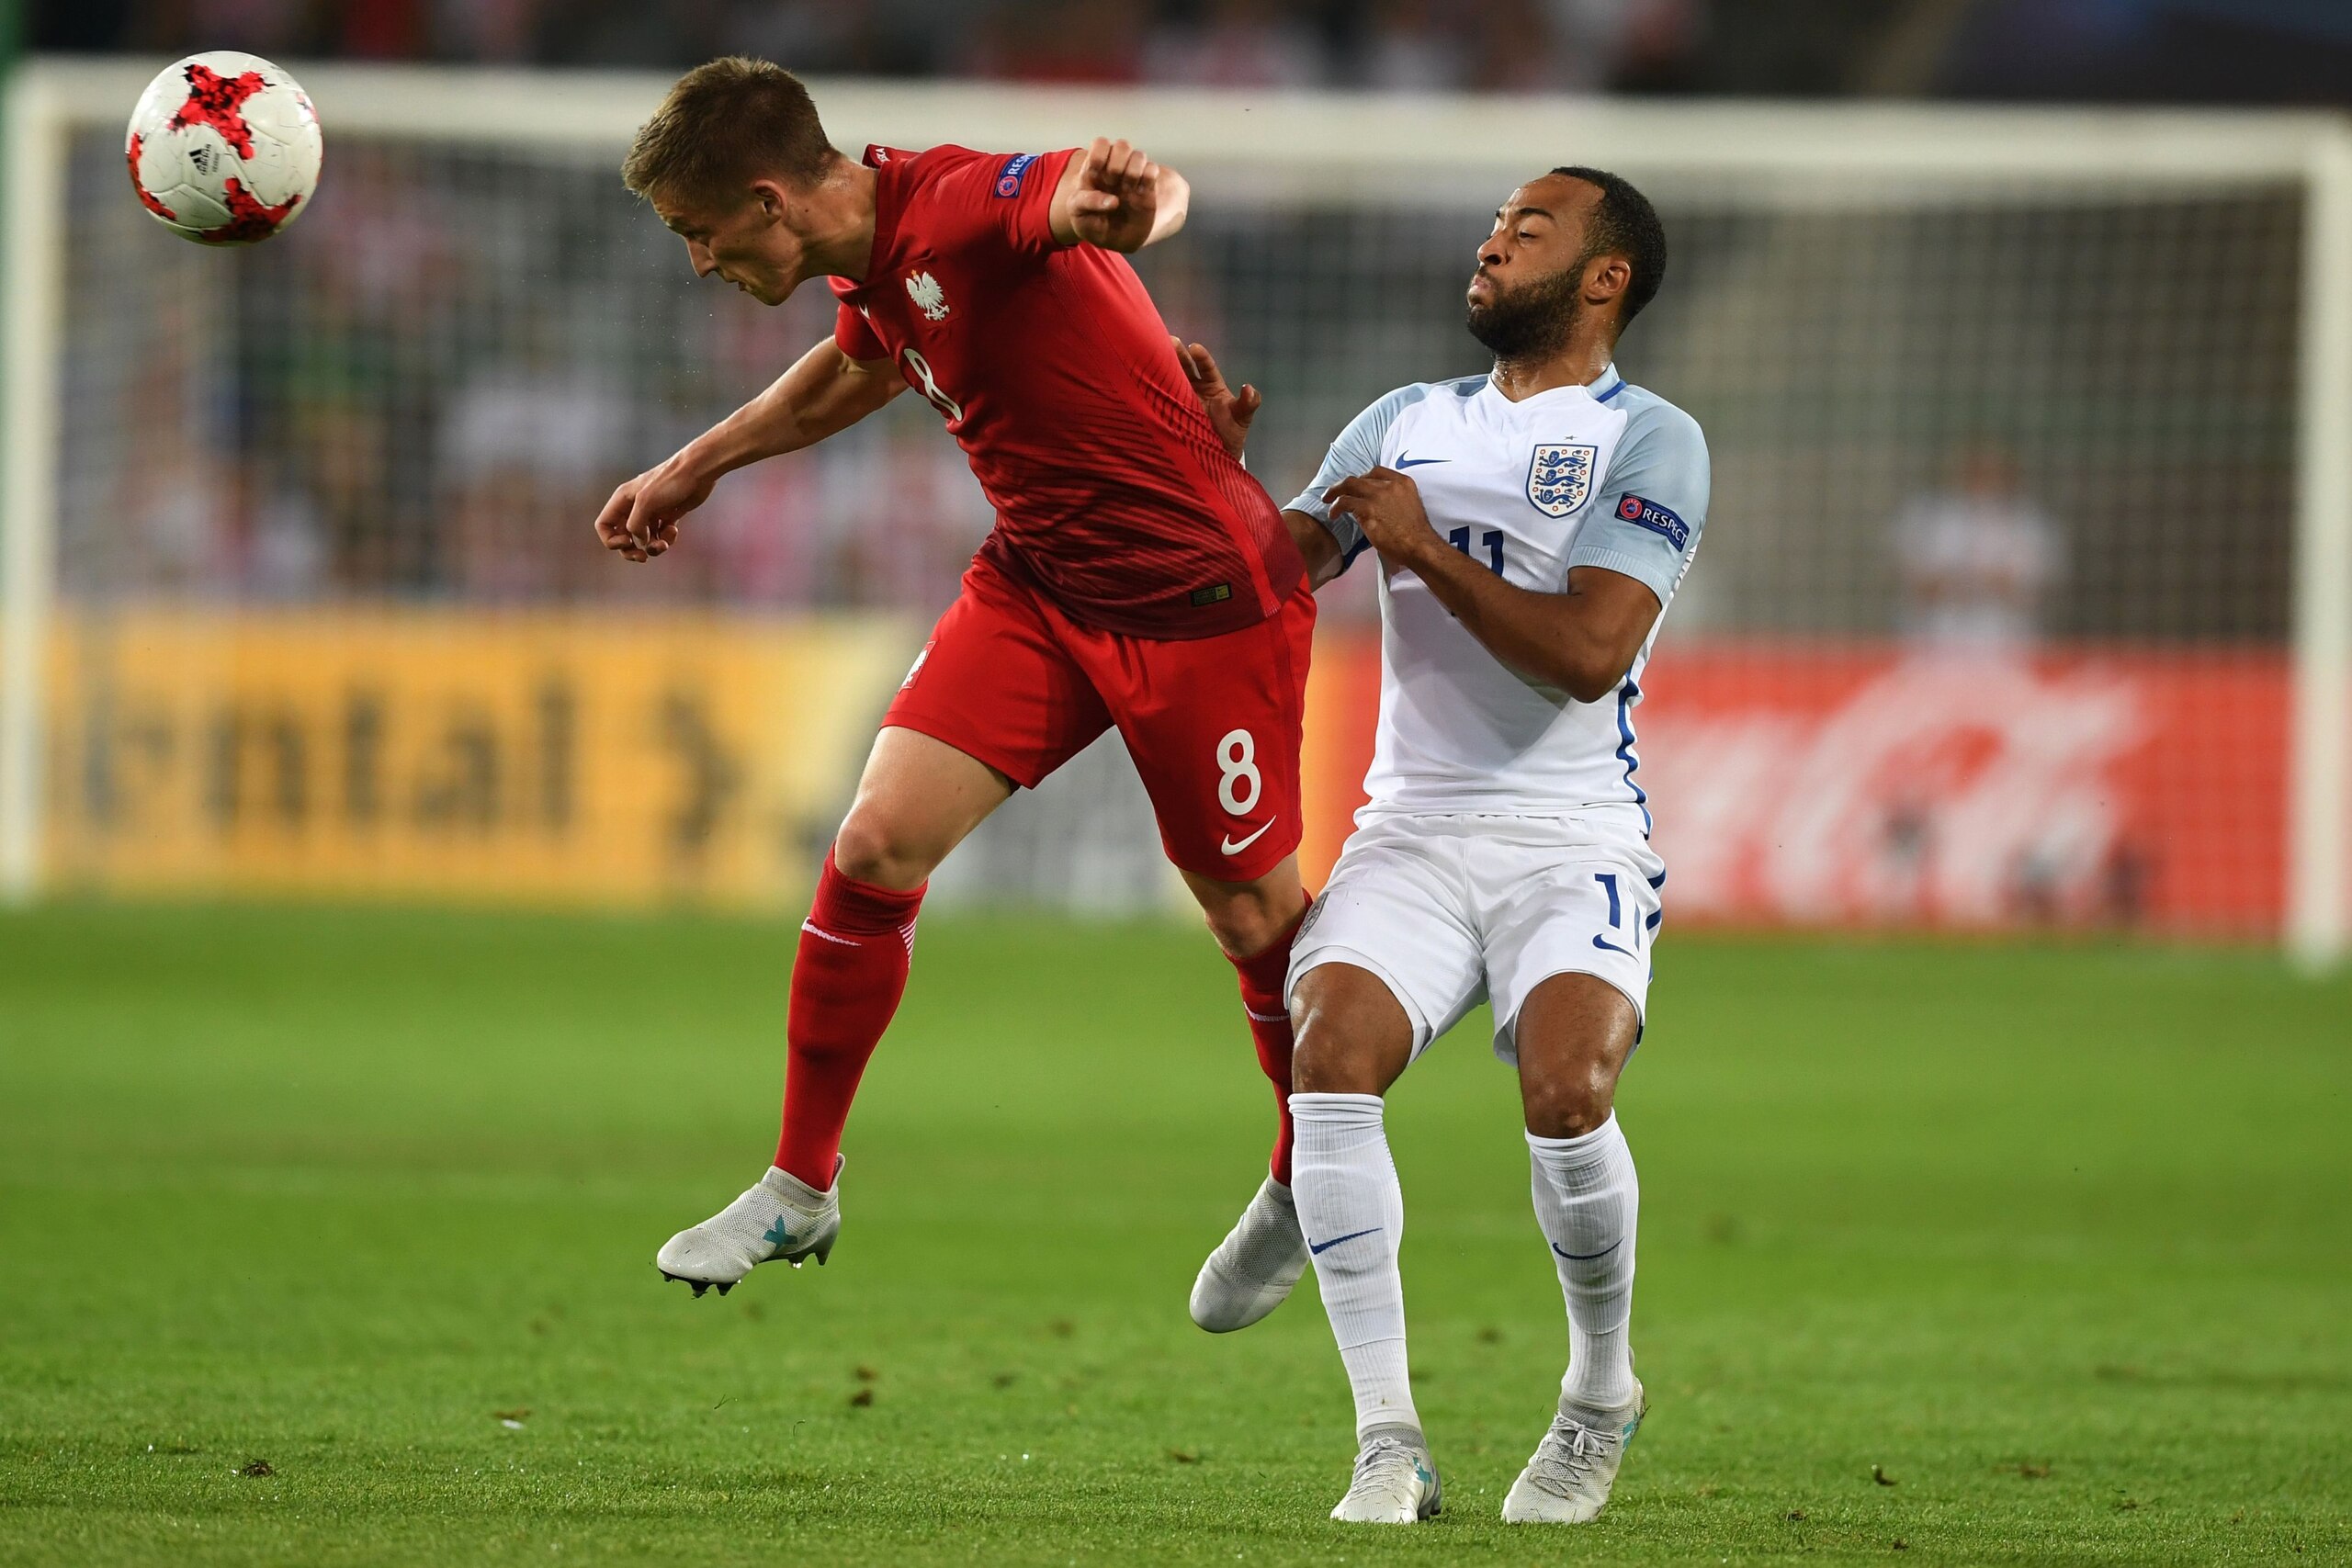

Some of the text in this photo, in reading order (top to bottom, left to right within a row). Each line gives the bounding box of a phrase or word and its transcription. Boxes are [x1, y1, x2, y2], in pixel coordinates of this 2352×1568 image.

[904, 348, 963, 422] 8
[1449, 525, 1504, 578] 11
[1643, 508, 1688, 545] RESPECT
[1216, 728, 1261, 816] 8
